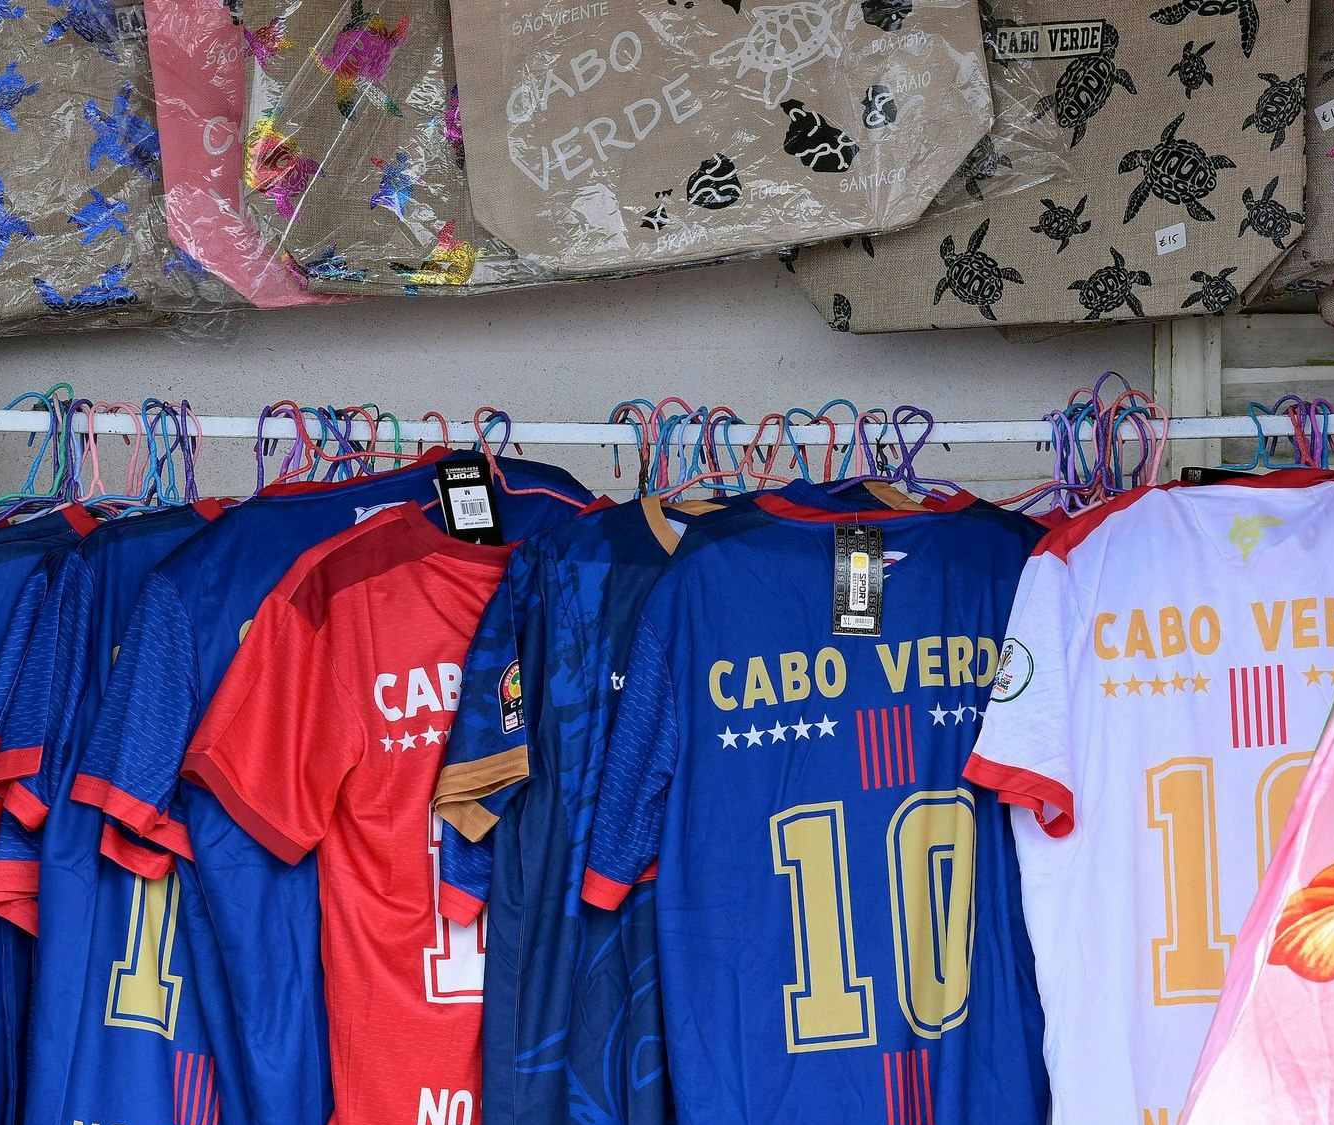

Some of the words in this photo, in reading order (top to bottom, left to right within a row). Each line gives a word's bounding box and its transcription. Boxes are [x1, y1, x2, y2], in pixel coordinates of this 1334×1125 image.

[549, 1, 609, 25] VICENTE
[998, 29, 1040, 55] CABO
[1047, 25, 1100, 52] VERDE
[507, 31, 643, 124] CABO
[896, 71, 931, 94] MAIO
[510, 73, 703, 191] VERDE
[750, 180, 790, 201] FOGO
[840, 167, 907, 193] SANTIAGO
[656, 228, 709, 253] BRAVA
[446, 471, 481, 481] SPORT
[858, 572, 867, 606] SPORT
[1093, 603, 1222, 660] CABO
[708, 645, 848, 712] CABO
[876, 635, 998, 693] VERD
[373, 661, 463, 722] CAB
[769, 786, 977, 1055] 10
